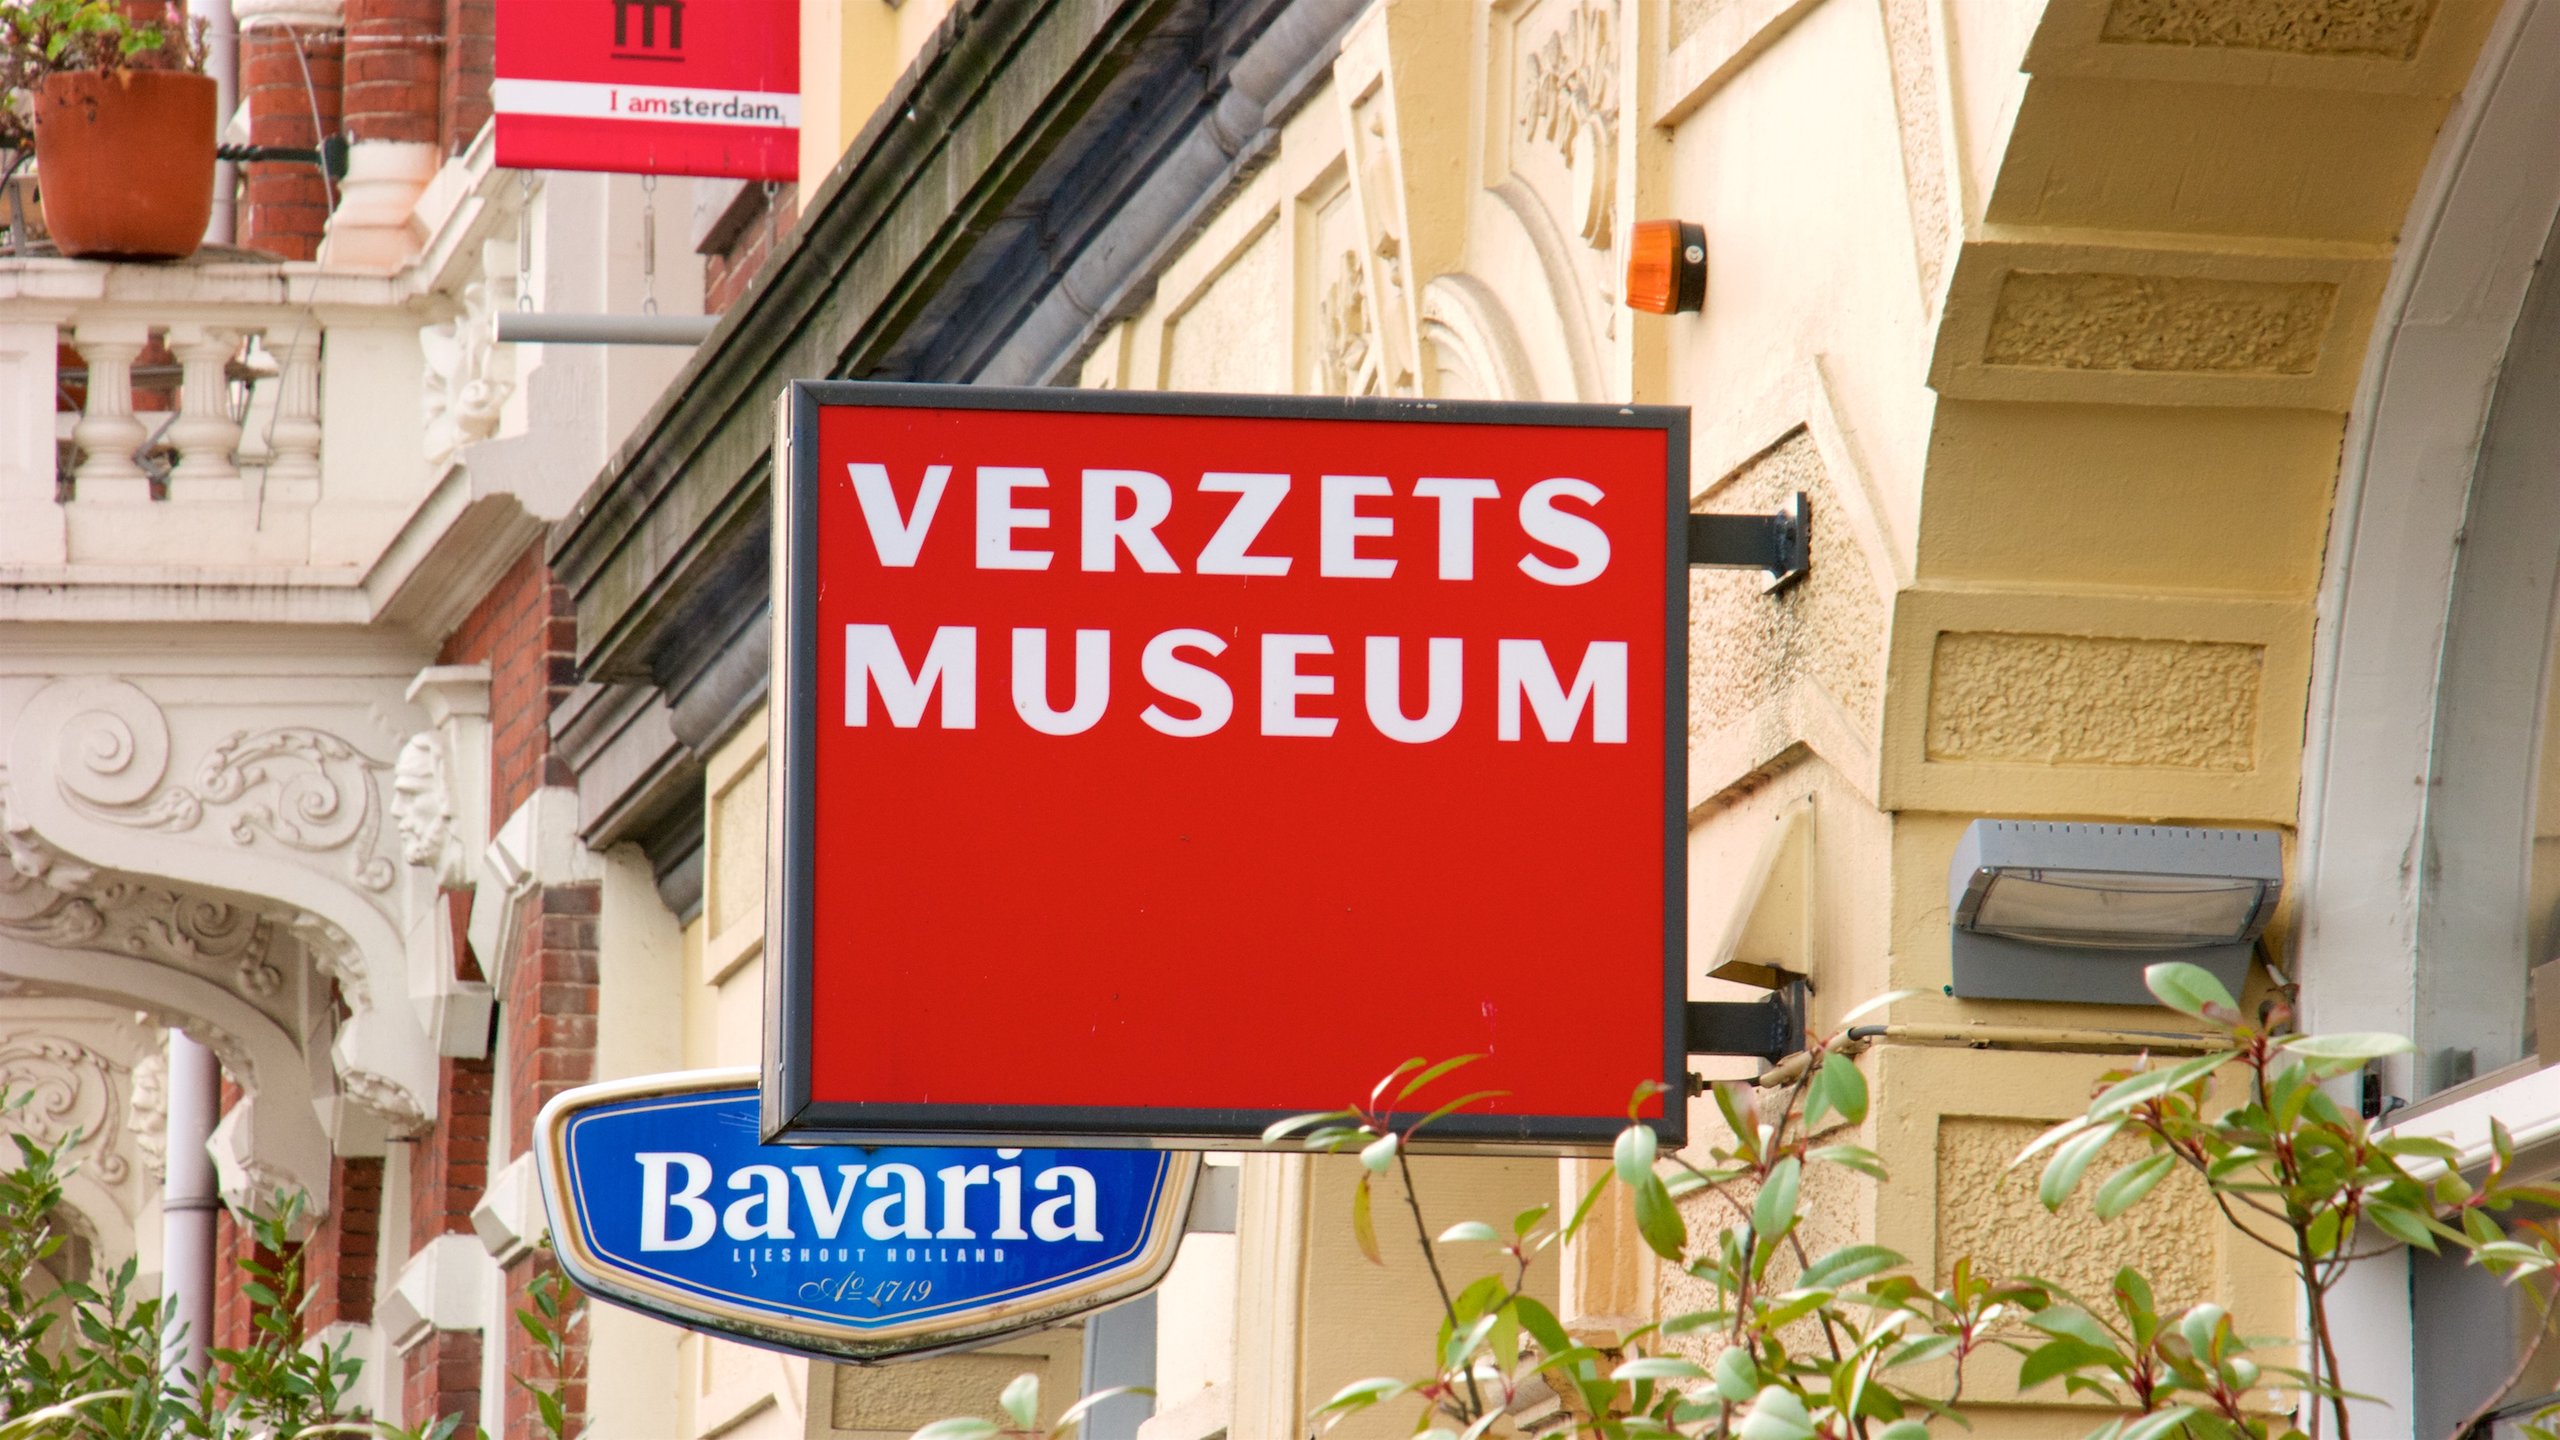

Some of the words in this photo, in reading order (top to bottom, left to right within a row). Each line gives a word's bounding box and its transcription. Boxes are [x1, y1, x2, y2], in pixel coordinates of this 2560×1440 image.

[610, 90, 617, 111] I
[628, 96, 779, 120] amsterdam
[847, 463, 1612, 586] VERZETS
[844, 623, 1628, 744] MUSEUM
[634, 1148, 1104, 1252] Bavaria
[733, 1248, 866, 1262] LIESHOUT
[887, 1248, 1005, 1262] HOLLAND
[869, 1279, 932, 1302] 1719
